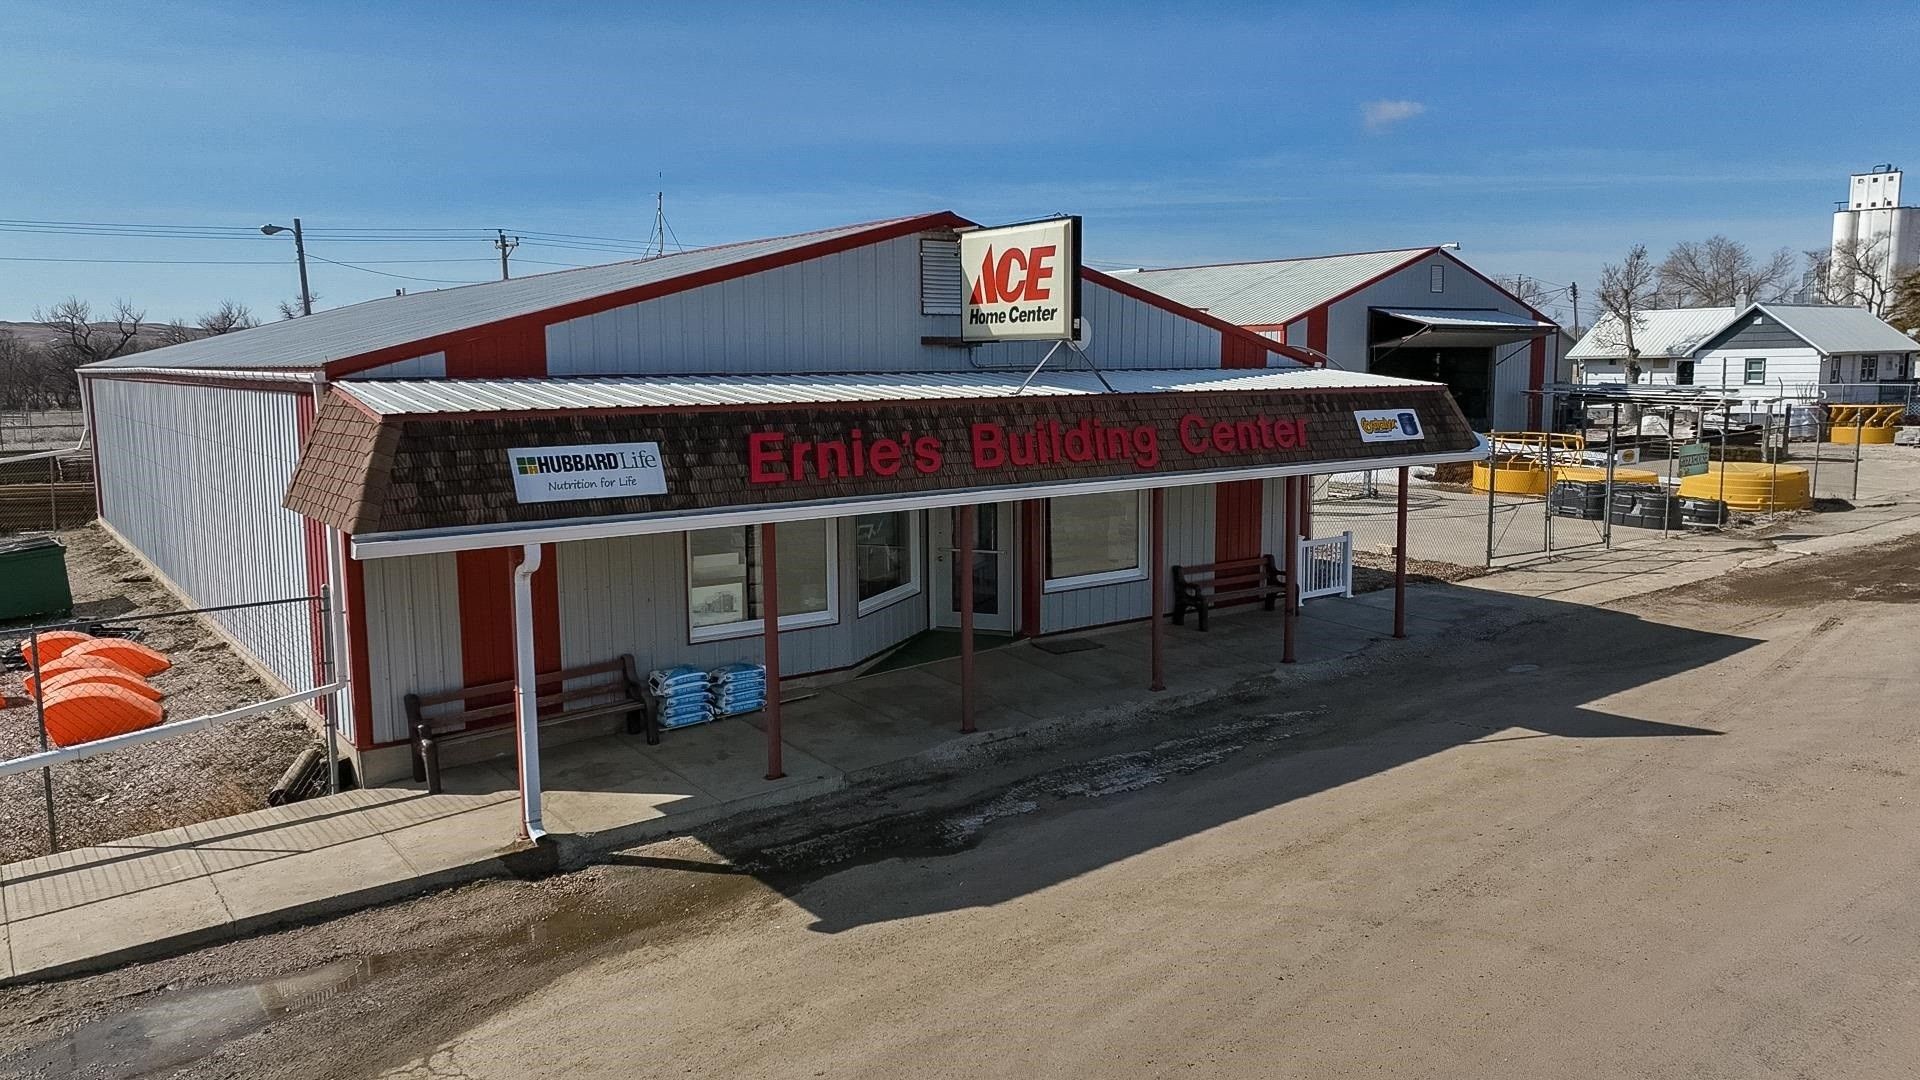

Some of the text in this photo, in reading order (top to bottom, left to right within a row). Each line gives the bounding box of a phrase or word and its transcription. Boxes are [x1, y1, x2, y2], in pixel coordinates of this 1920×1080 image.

[969, 243, 1057, 305] ACE
[969, 305, 1058, 325] Home Center
[748, 413, 1309, 484] Ernie's Building Center
[536, 450, 658, 474] HUBBARD Life
[548, 476, 638, 491] Nutrition for Life
